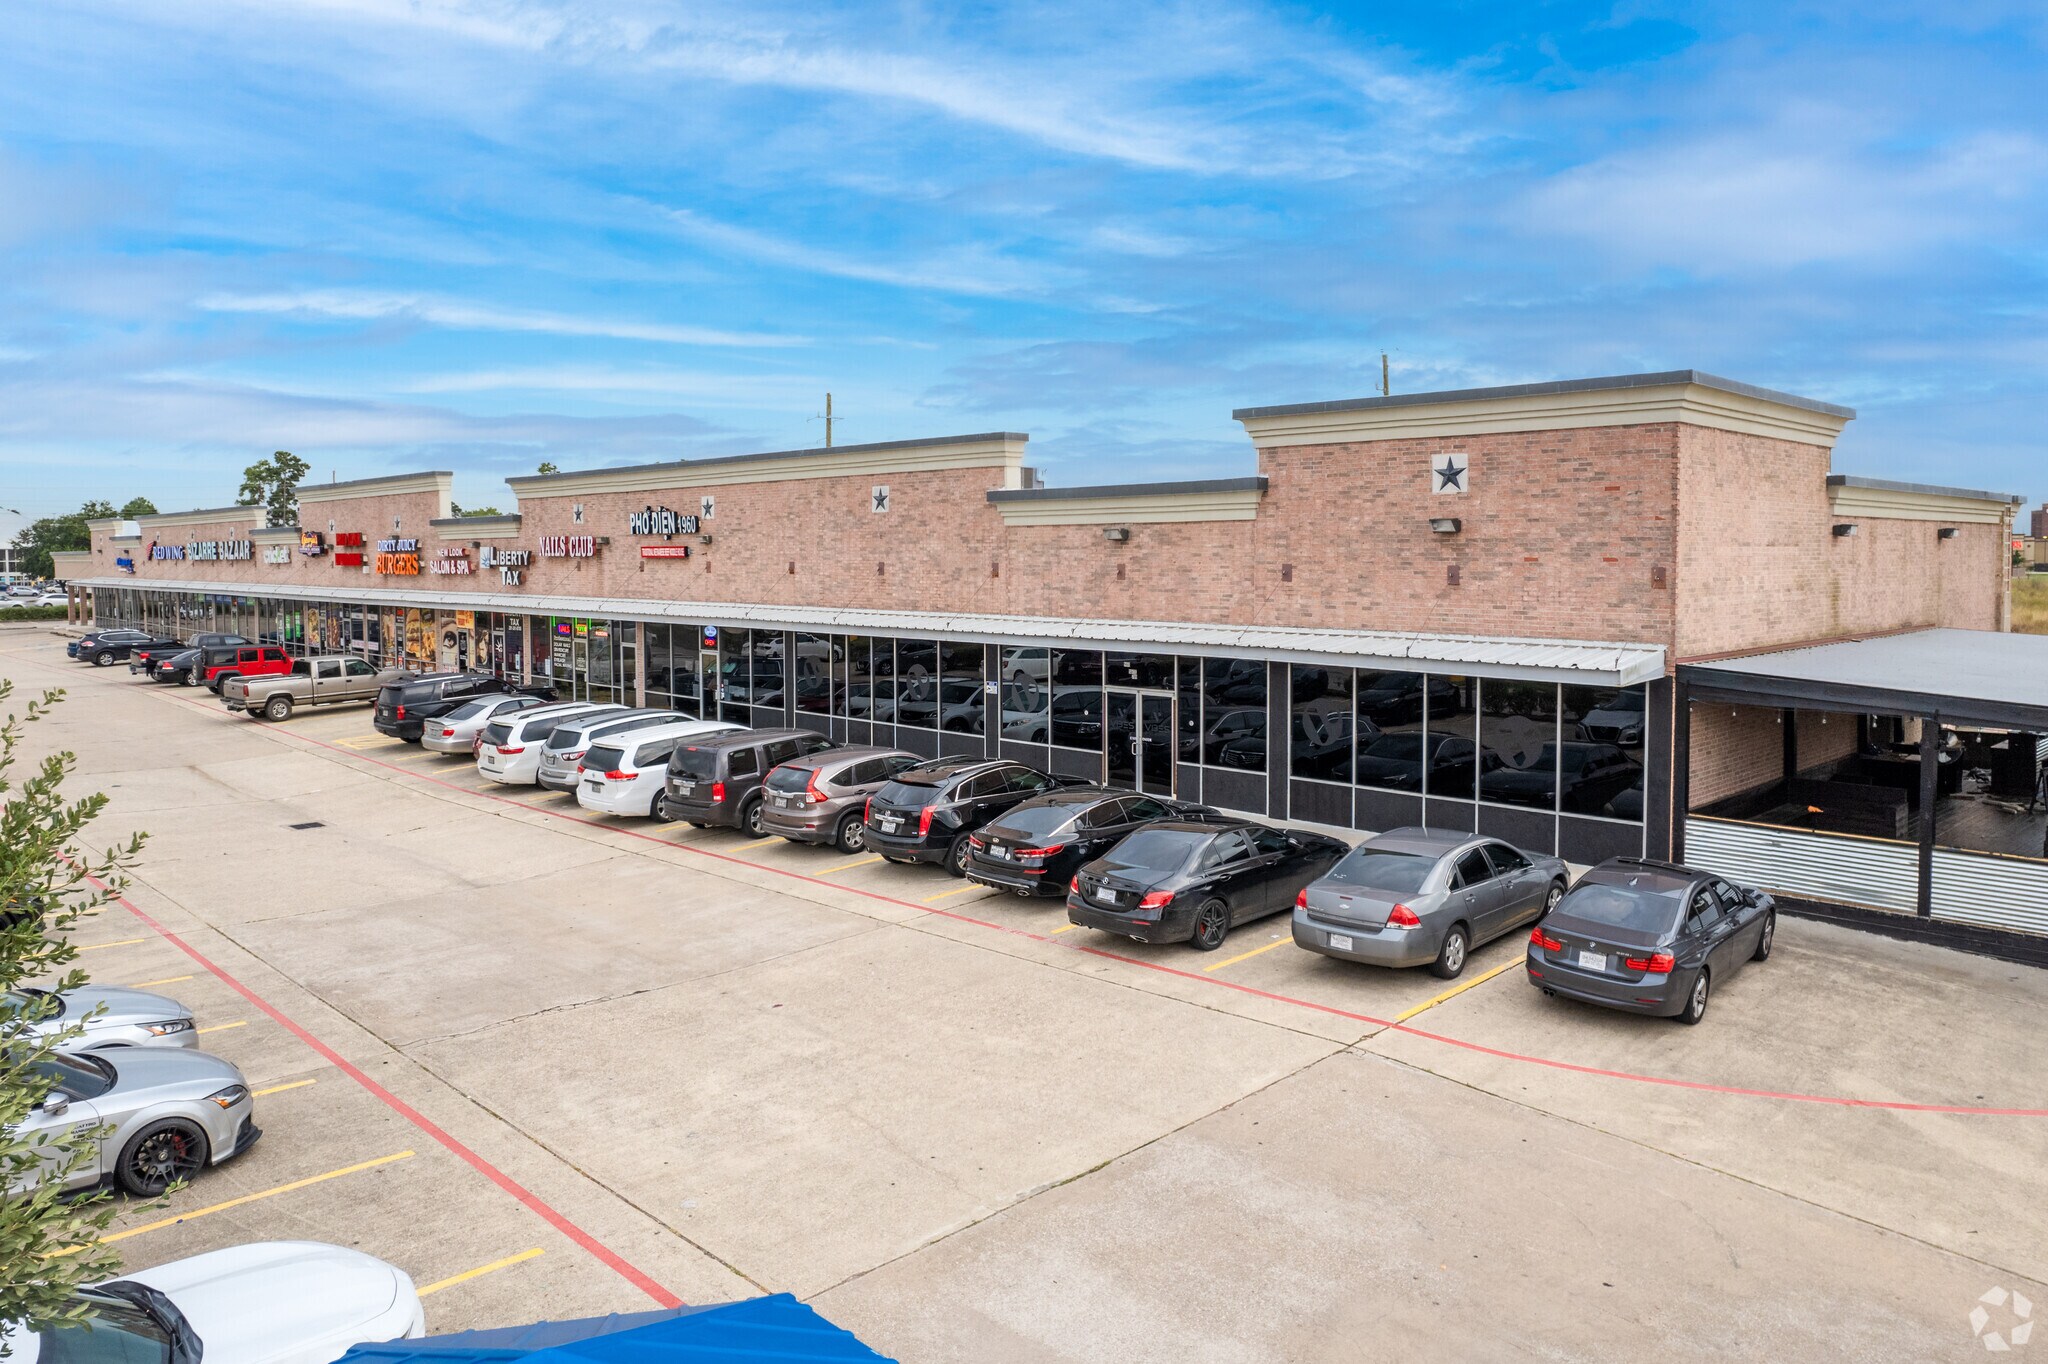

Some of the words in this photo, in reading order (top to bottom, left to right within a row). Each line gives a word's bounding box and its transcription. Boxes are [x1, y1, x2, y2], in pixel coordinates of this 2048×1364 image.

[678, 515, 697, 533] 1960
[153, 546, 165, 560] RED
[165, 545, 184, 560] WING
[187, 542, 218, 560] BIZARRE
[219, 540, 252, 560] BAZAAR
[377, 540, 396, 551] DIRTY
[397, 539, 416, 551] JUICY
[449, 548, 463, 556] LOOK
[539, 536, 566, 557] NAILS
[569, 535, 594, 558] CLUB
[376, 554, 419, 575] BURGERS
[429, 560, 449, 574] SALON
[450, 560, 456, 573] &
[456, 560, 470, 575] SPA
[500, 567, 520, 586] TAX
[510, 618, 520, 626] TAX
